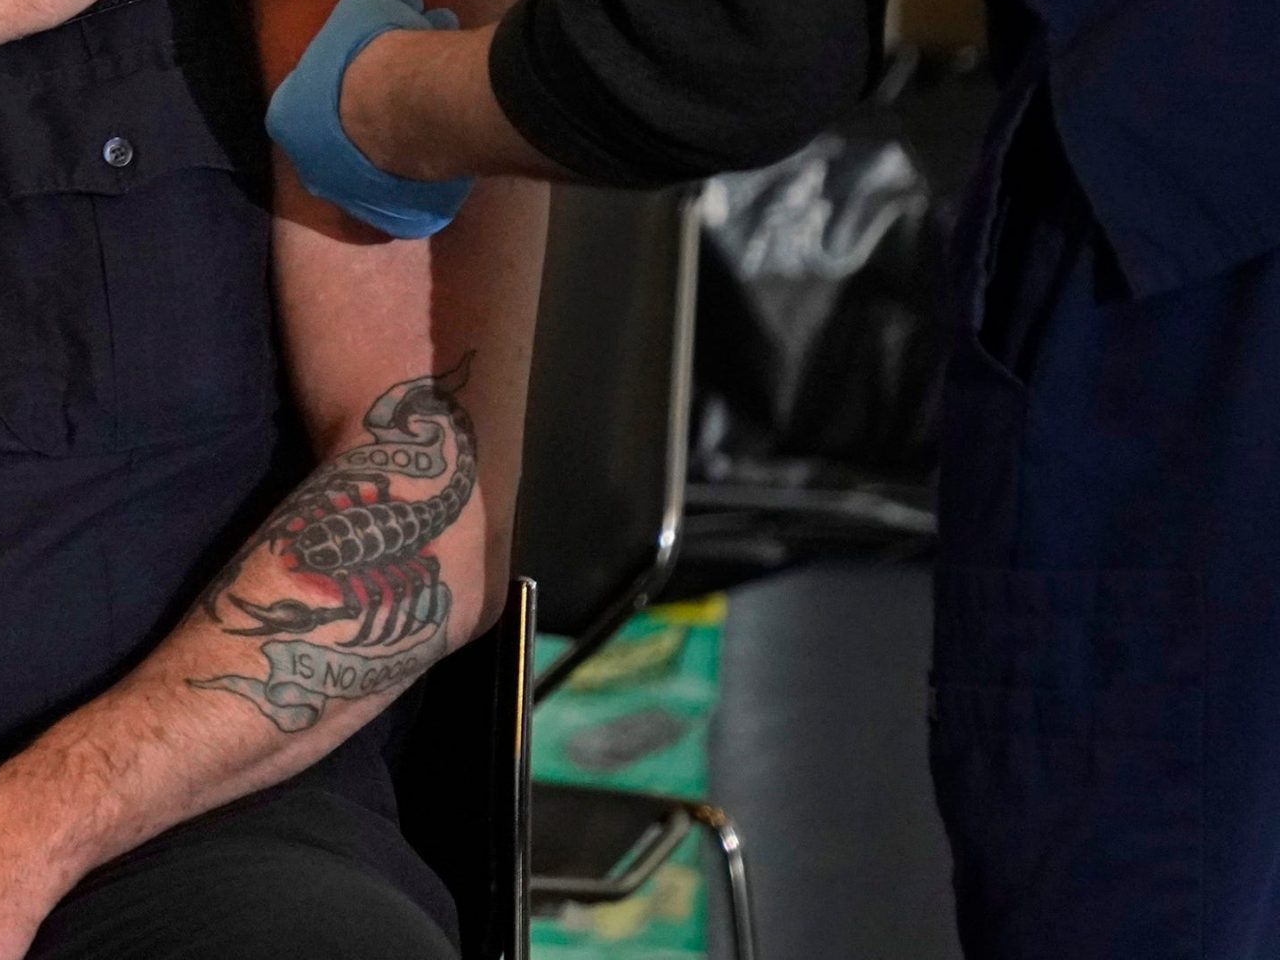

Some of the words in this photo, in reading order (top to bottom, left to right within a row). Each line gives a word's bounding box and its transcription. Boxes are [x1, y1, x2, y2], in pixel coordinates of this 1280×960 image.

[347, 449, 432, 472] GOOD
[291, 653, 315, 680] IS
[322, 661, 357, 690] NO
